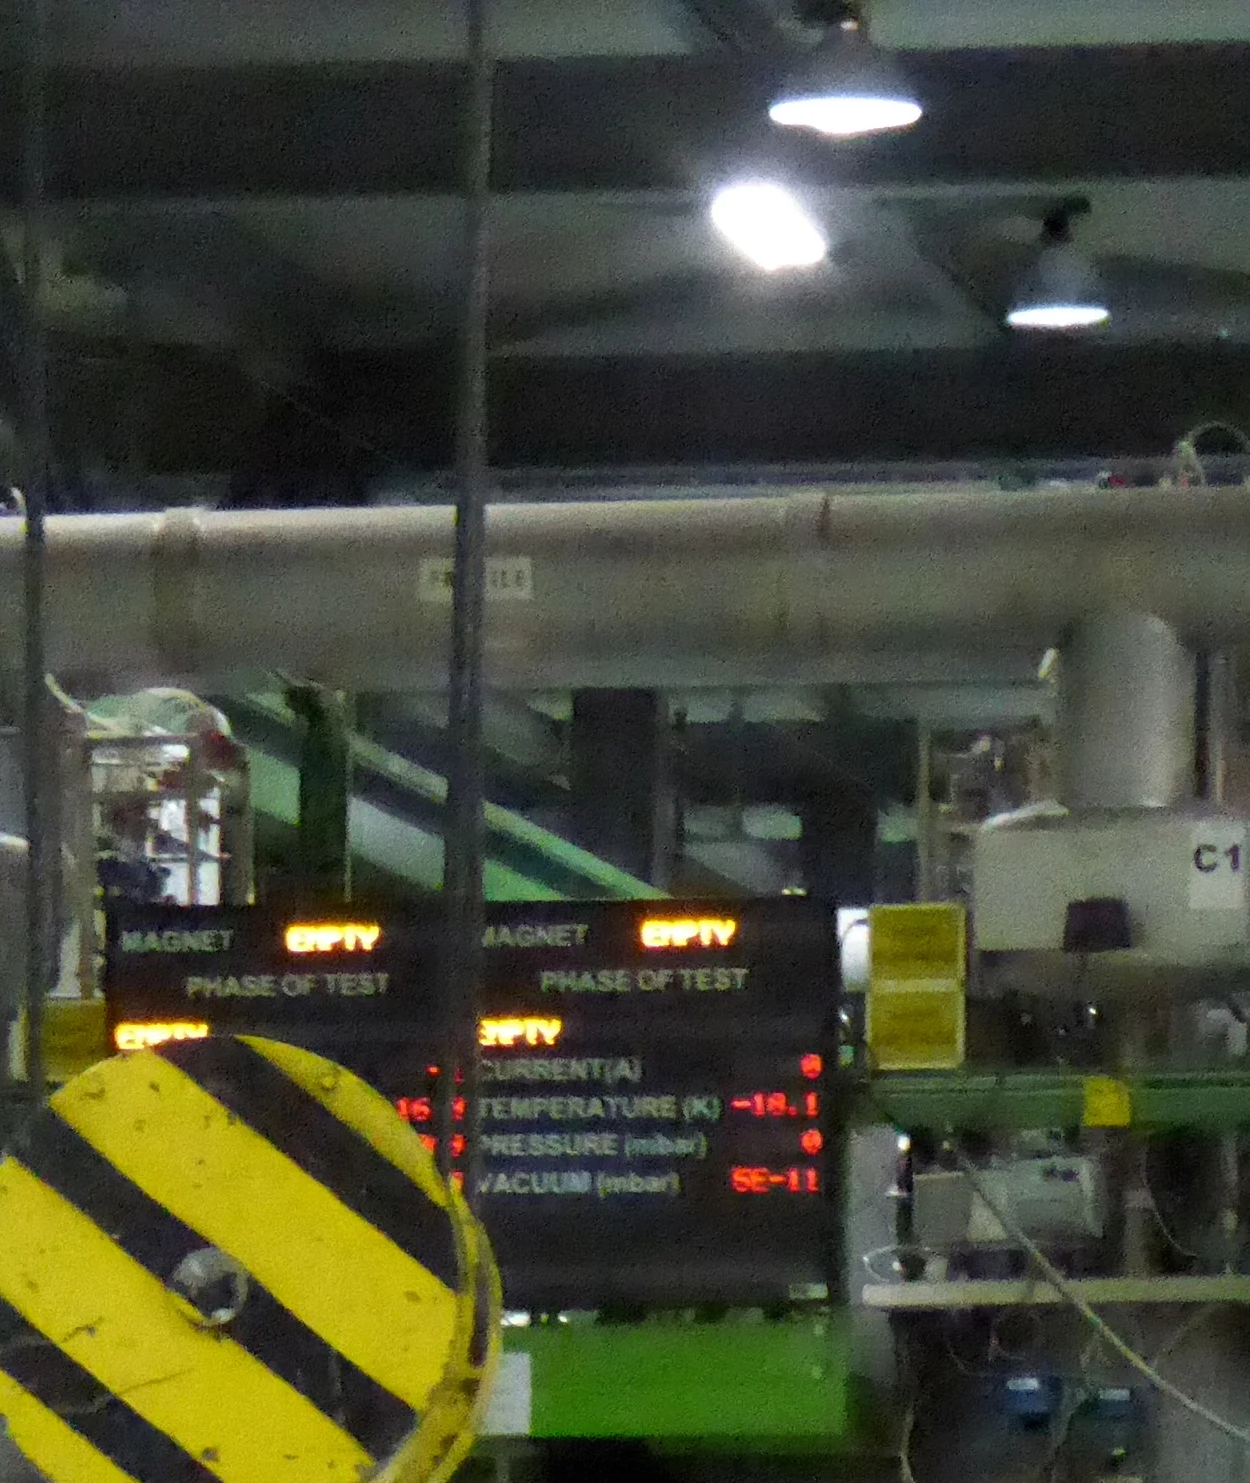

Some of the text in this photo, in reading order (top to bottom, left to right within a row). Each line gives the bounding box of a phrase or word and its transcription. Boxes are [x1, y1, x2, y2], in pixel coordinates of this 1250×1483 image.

[1193, 843, 1241, 873] C1
[121, 923, 381, 952] MAGNET EMPTY
[640, 918, 738, 947] EMPTY
[185, 971, 390, 999] PHASE OF TEST
[540, 967, 749, 993] PHASE OF TEST
